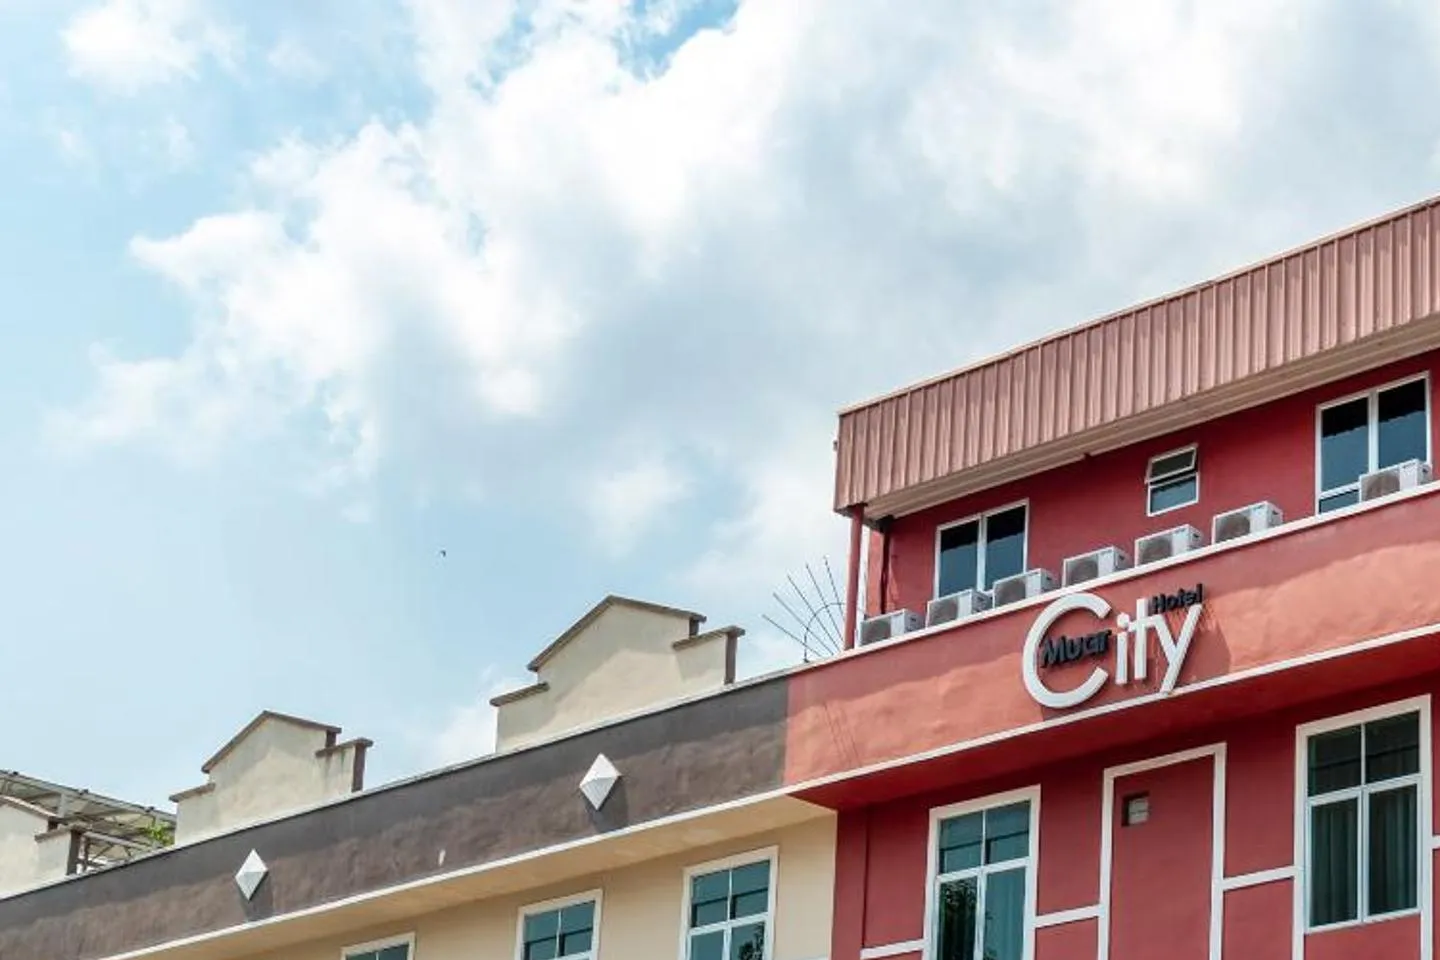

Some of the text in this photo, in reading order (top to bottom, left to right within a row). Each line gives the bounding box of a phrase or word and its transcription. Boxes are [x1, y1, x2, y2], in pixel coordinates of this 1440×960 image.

[1151, 583, 1203, 614] Hotel
[1022, 592, 1203, 709] City
[1040, 629, 1113, 668] Muar
